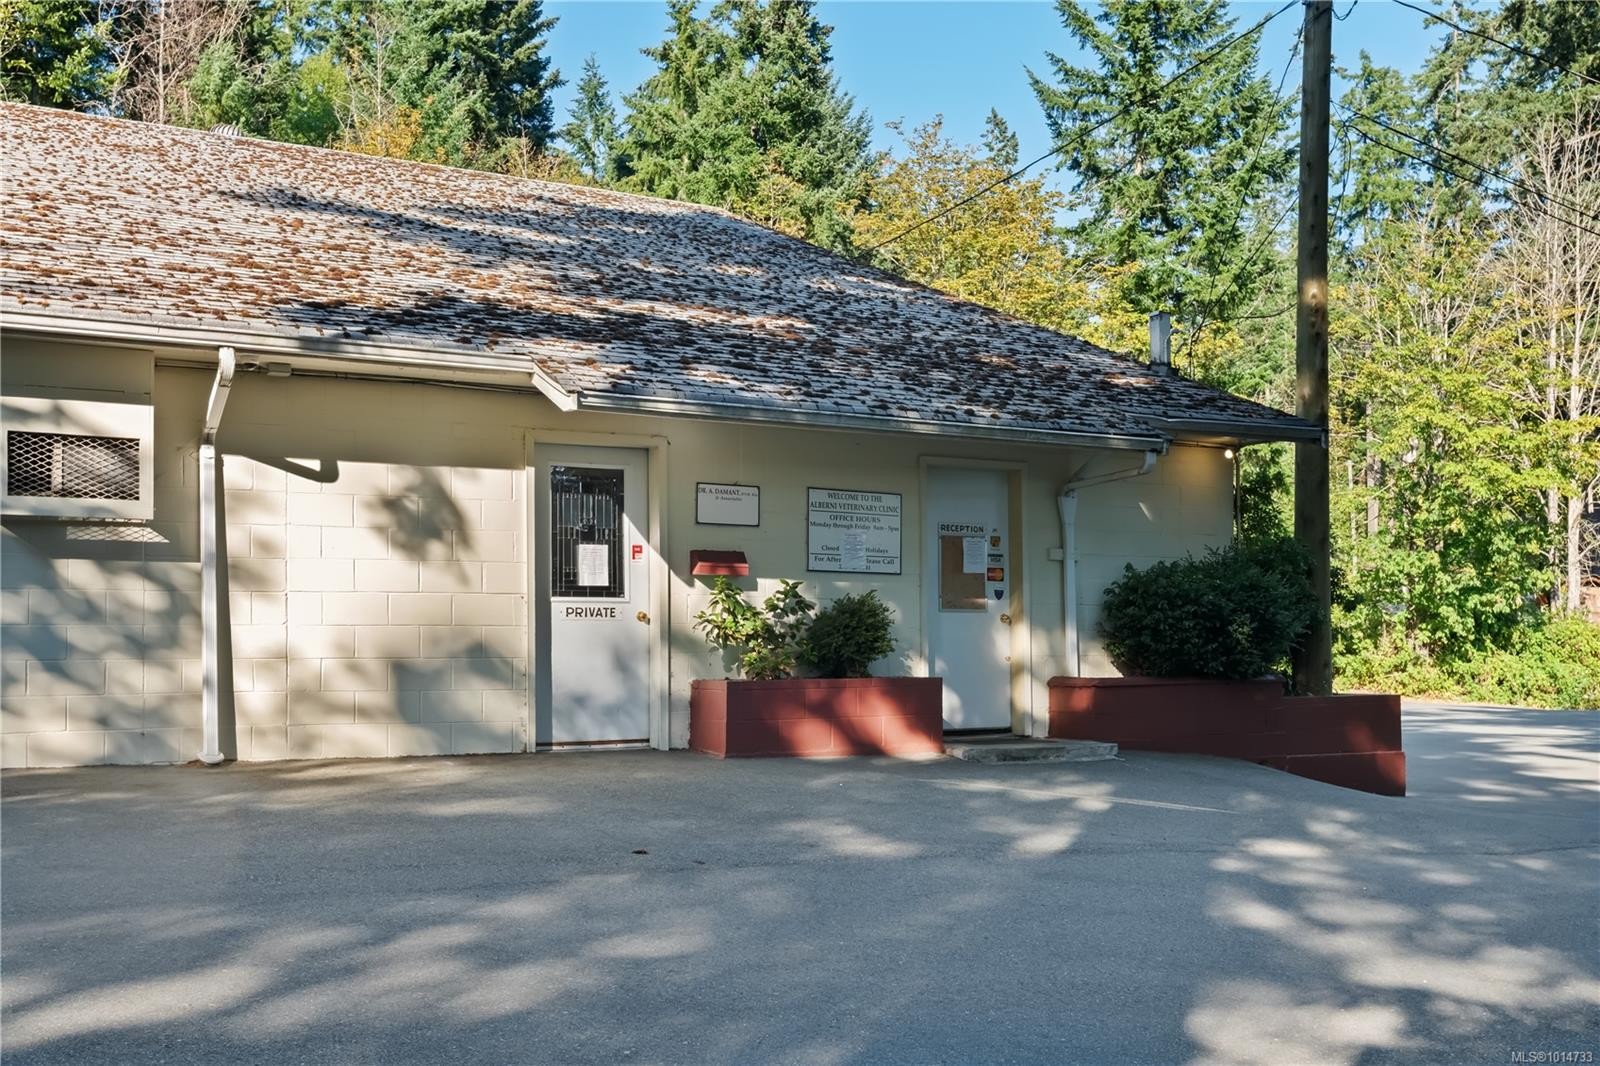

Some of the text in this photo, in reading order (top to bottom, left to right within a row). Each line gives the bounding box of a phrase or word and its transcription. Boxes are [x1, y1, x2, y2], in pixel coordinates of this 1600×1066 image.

[828, 492, 859, 502] WELCOME
[810, 501, 899, 513] ALBERNI VETERINARY CLINIC
[829, 514, 881, 523] OFFICE HOURS
[810, 521, 831, 529] Monday
[833, 522, 854, 530] through
[940, 524, 984, 533] RECEPTION
[821, 544, 889, 554] Closed Holidays
[565, 606, 616, 618] PRIVATE
